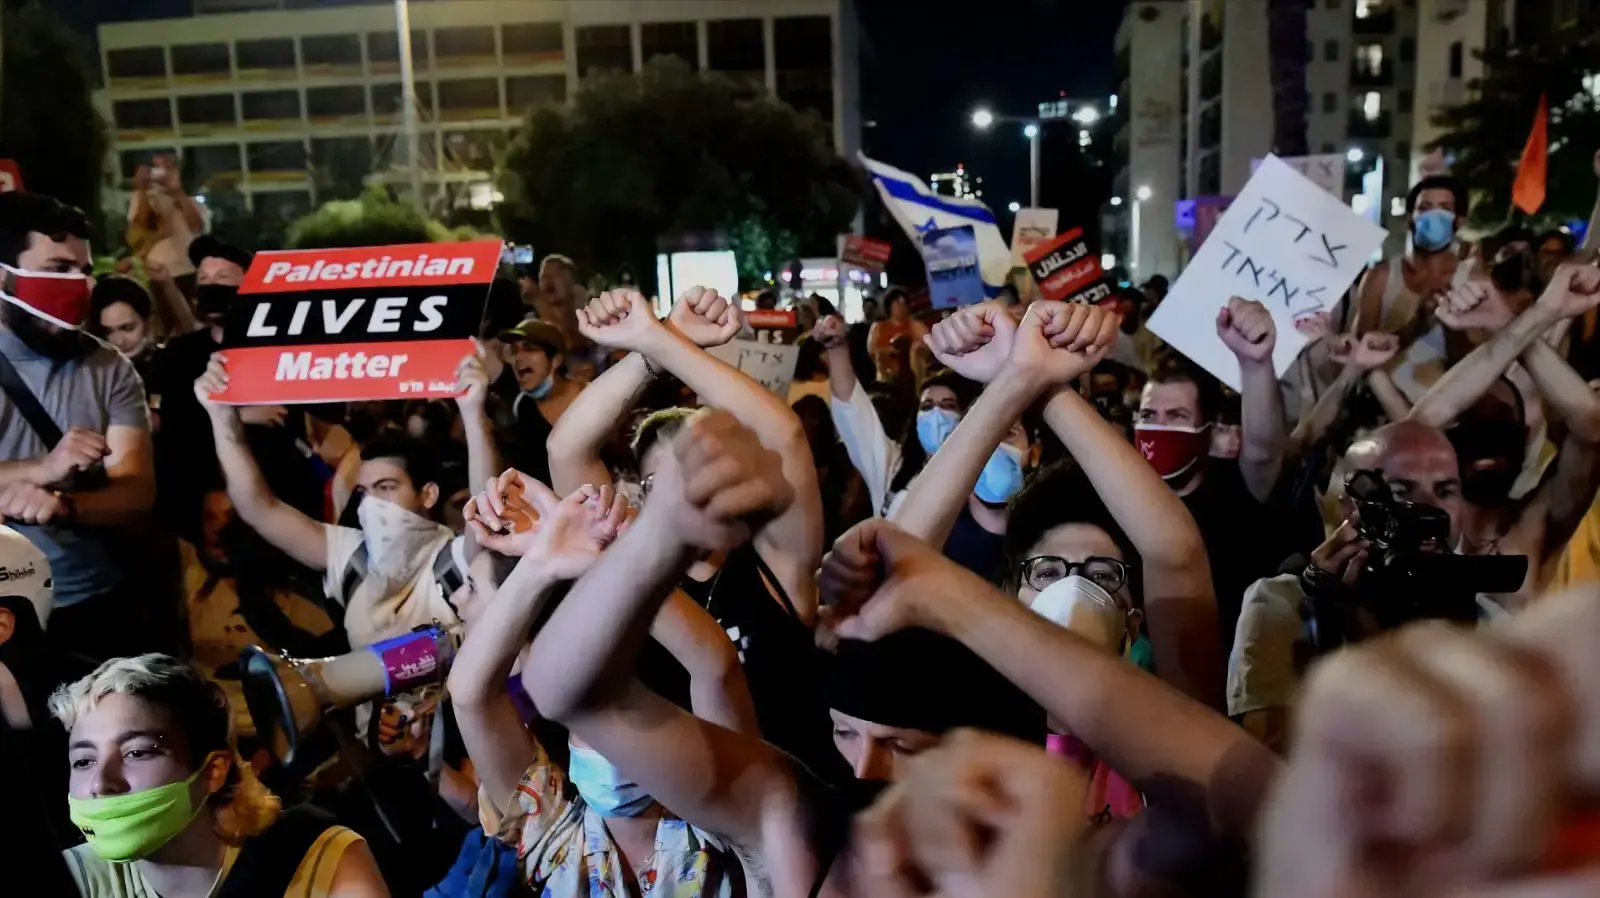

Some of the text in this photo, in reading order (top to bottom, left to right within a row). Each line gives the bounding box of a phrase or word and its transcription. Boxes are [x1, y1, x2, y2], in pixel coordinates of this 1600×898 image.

[1243, 197, 1348, 270] צדק
[262, 253, 475, 284] Palestinian
[246, 295, 448, 337] LIVES
[275, 351, 408, 381] Matter
